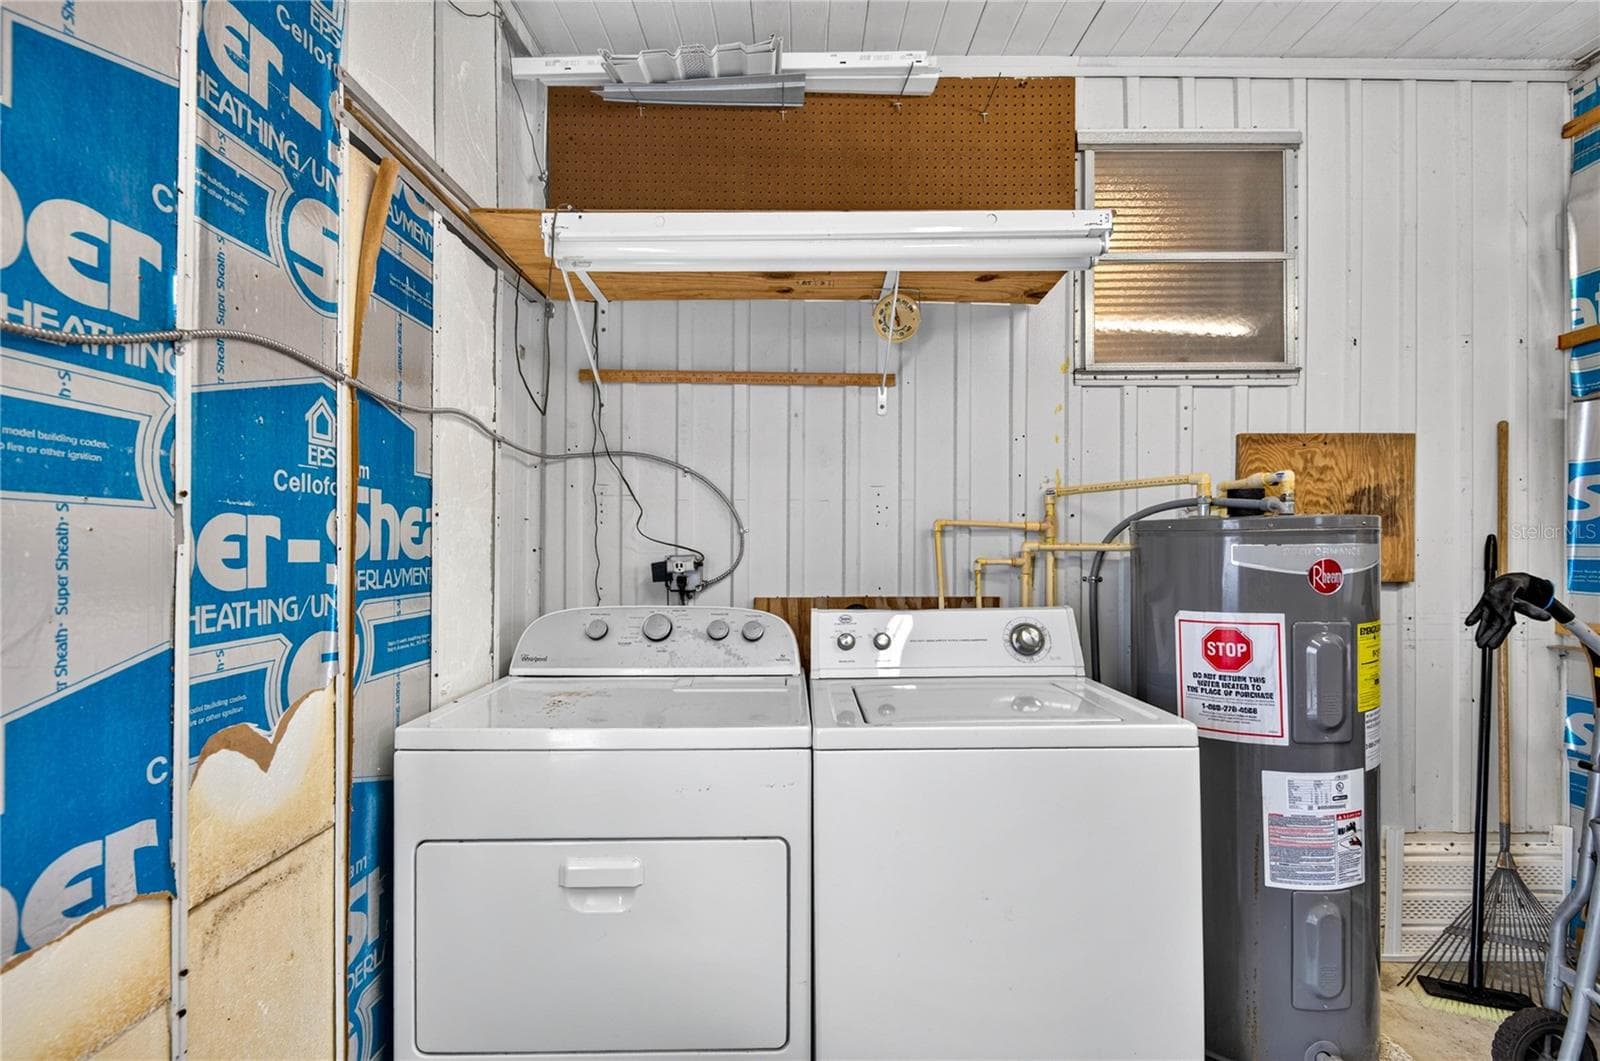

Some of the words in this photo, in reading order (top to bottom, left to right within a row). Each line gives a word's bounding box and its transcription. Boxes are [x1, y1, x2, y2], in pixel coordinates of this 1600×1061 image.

[2, 427, 36, 438] model
[38, 431, 78, 446] building
[7, 442, 25, 452] fire
[26, 446, 38, 454] or
[40, 448, 66, 458] other
[68, 450, 103, 462] ignition
[308, 445, 336, 469] EPS
[55, 520, 70, 572] Sheath
[1312, 560, 1342, 589] Rheem
[55, 575, 71, 616] Super
[55, 627, 69, 677] Sheath
[1206, 641, 1248, 658] STOP
[1192, 671, 1202, 679] DO
[1218, 674, 1247, 683] RETURN
[1248, 676, 1266, 684] THIS
[1197, 680, 1220, 688] WATER
[1222, 682, 1250, 691] HEATER
[1251, 684, 1262, 692] TO
[1186, 685, 1199, 693] THE
[1200, 686, 1222, 696] PLACE
[1223, 689, 1233, 697] OF
[1235, 691, 1274, 700] PURCHASE
